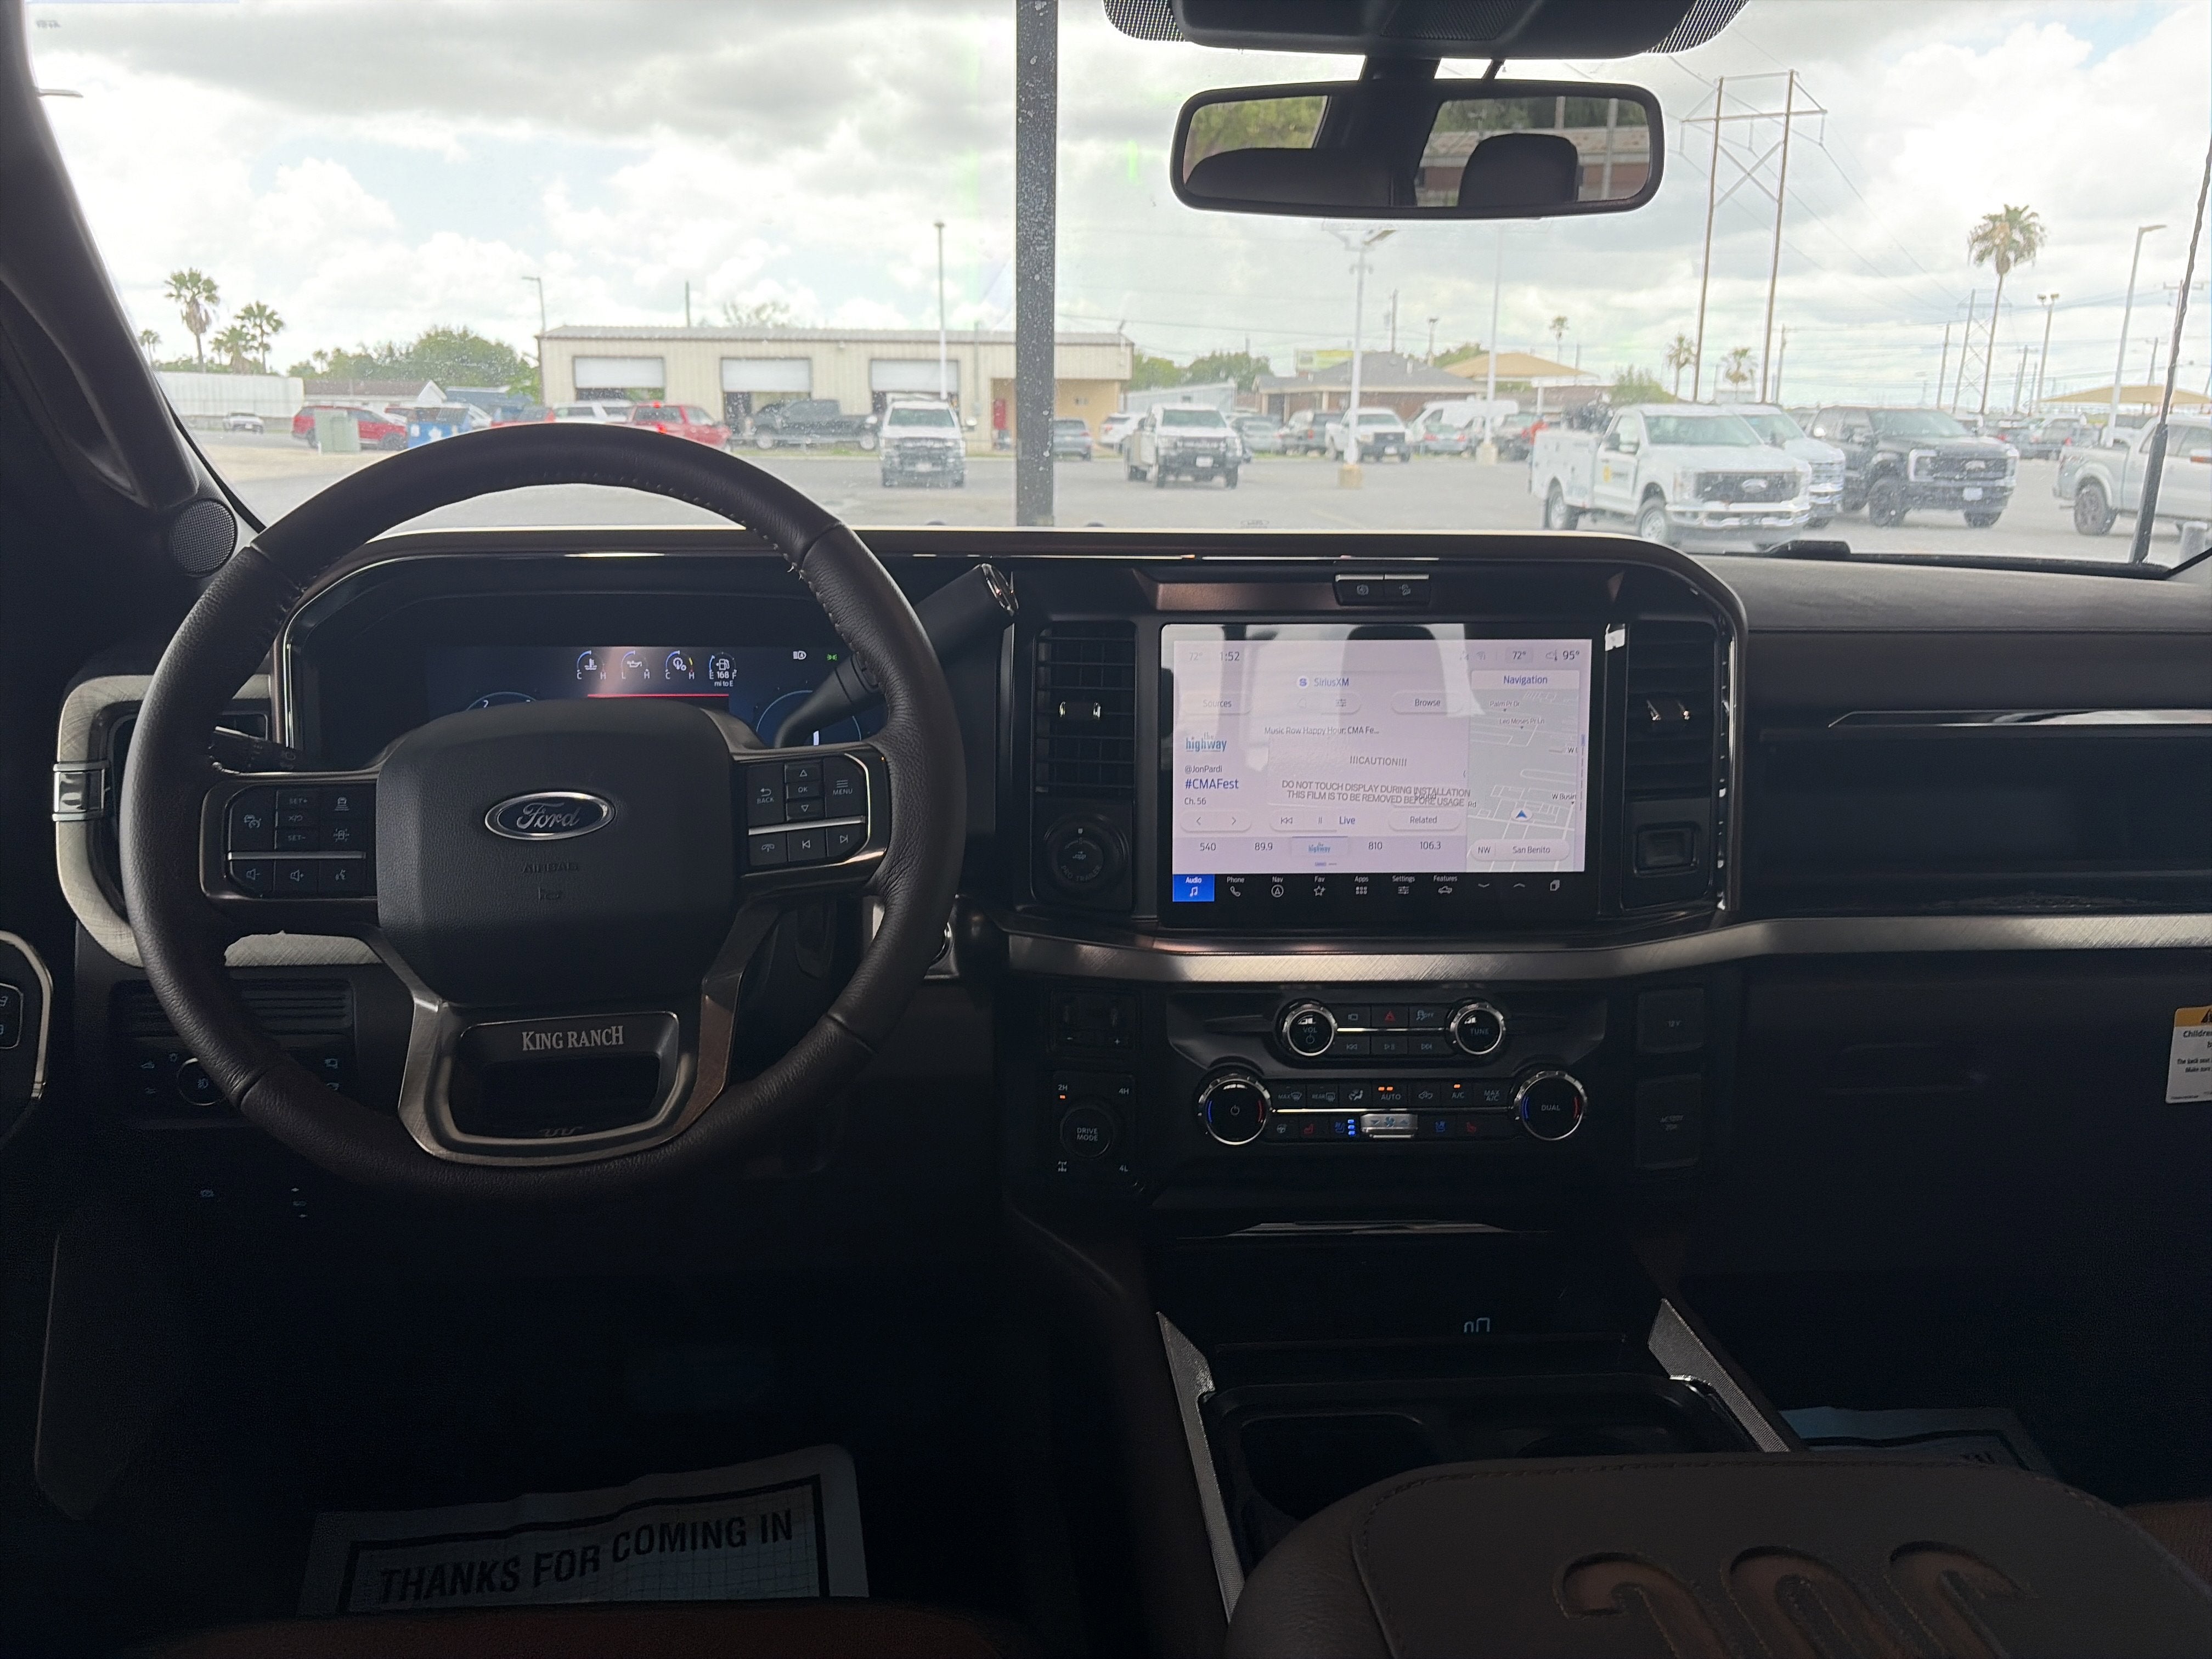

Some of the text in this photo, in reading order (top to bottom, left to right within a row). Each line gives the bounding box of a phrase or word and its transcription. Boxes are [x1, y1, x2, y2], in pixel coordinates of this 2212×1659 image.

[1220, 651, 1240, 662] 1:52
[1562, 650, 1580, 660] 95°
[1314, 677, 1349, 687] SiriusXM
[1503, 675, 1548, 686] Navigation
[1203, 699, 1232, 708] Sources
[1414, 698, 1441, 707] Browse
[1303, 726, 1325, 735] Happy
[1186, 737, 1227, 752] highway
[1185, 778, 1239, 790] #CMAFest
[1282, 780, 1470, 797] DO NOT TOUCH DISPLAY DURING INSTALLATION
[1197, 797, 1206, 805] 56
[1287, 790, 1464, 807] THIS FILM IS TO BE REMOVED BEFORE USAGE
[516, 802, 580, 829] Ford
[1410, 815, 1437, 823] Related
[1339, 816, 1356, 825] Live
[1199, 842, 1216, 851] 540
[1255, 842, 1273, 851] 89.9
[1368, 841, 1383, 850] 810
[1420, 840, 1441, 850] 106.3
[1513, 845, 1550, 854] San Benito
[1477, 846, 1491, 854] NW
[1392, 875, 1415, 883] Settings
[522, 1025, 624, 1051] KING RANCH
[380, 1509, 793, 1604] THANKS FOR COMING IN
